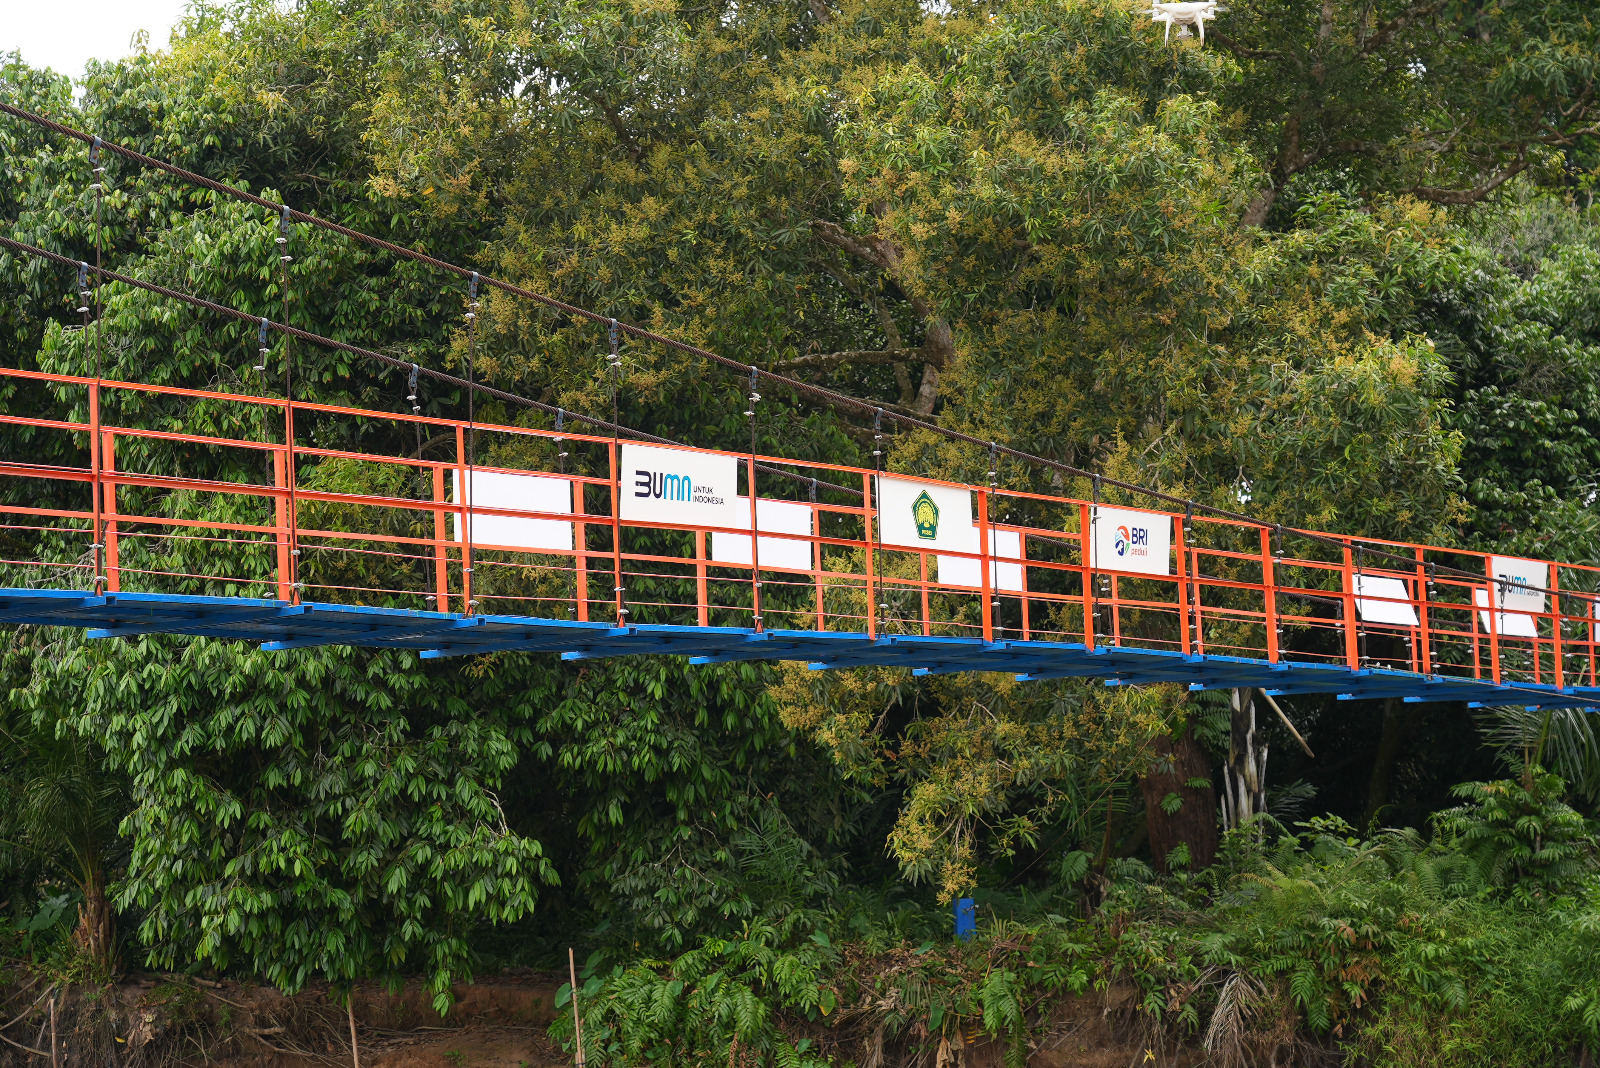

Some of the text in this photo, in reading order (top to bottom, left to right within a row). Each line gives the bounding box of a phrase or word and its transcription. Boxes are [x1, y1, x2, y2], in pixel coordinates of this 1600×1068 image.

[693, 485, 714, 495] UNTUK
[693, 495, 725, 505] INDONESIA
[1131, 527, 1148, 546] BRI
